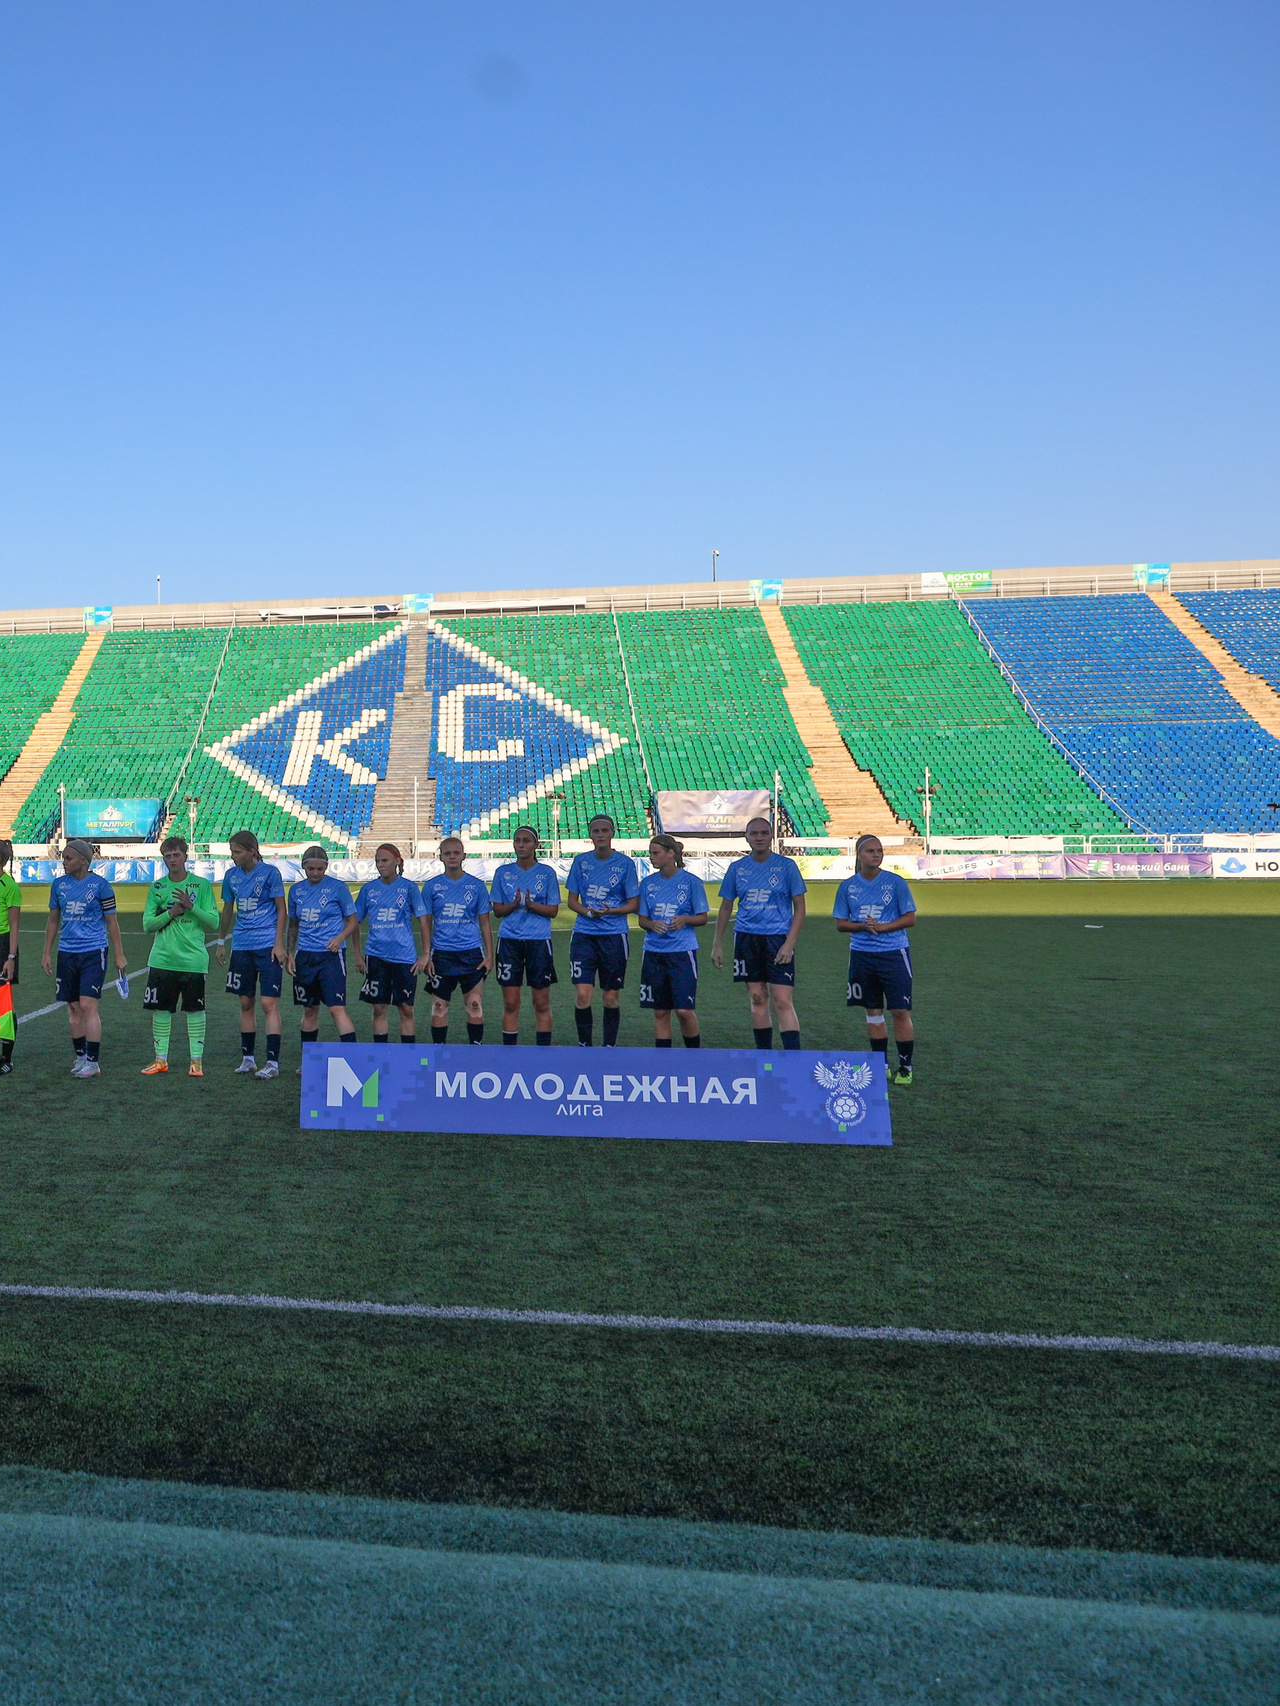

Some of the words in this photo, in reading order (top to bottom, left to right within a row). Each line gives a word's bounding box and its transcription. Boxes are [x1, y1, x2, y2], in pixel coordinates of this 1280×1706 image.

[946, 572, 990, 581] ВОСТОК
[84, 612, 94, 620] 15
[281, 708, 387, 787] К
[1112, 862, 1161, 872] Земский
[1163, 861, 1191, 872] банк
[570, 960, 583, 979] 5
[225, 971, 242, 990] 15
[360, 978, 380, 997] 45
[428, 976, 443, 989] 5
[144, 987, 159, 1004] 91
[294, 985, 308, 1001] 12
[639, 984, 655, 1002] 31
[434, 1070, 758, 1105] МОЛОДЕЖНАЯ
